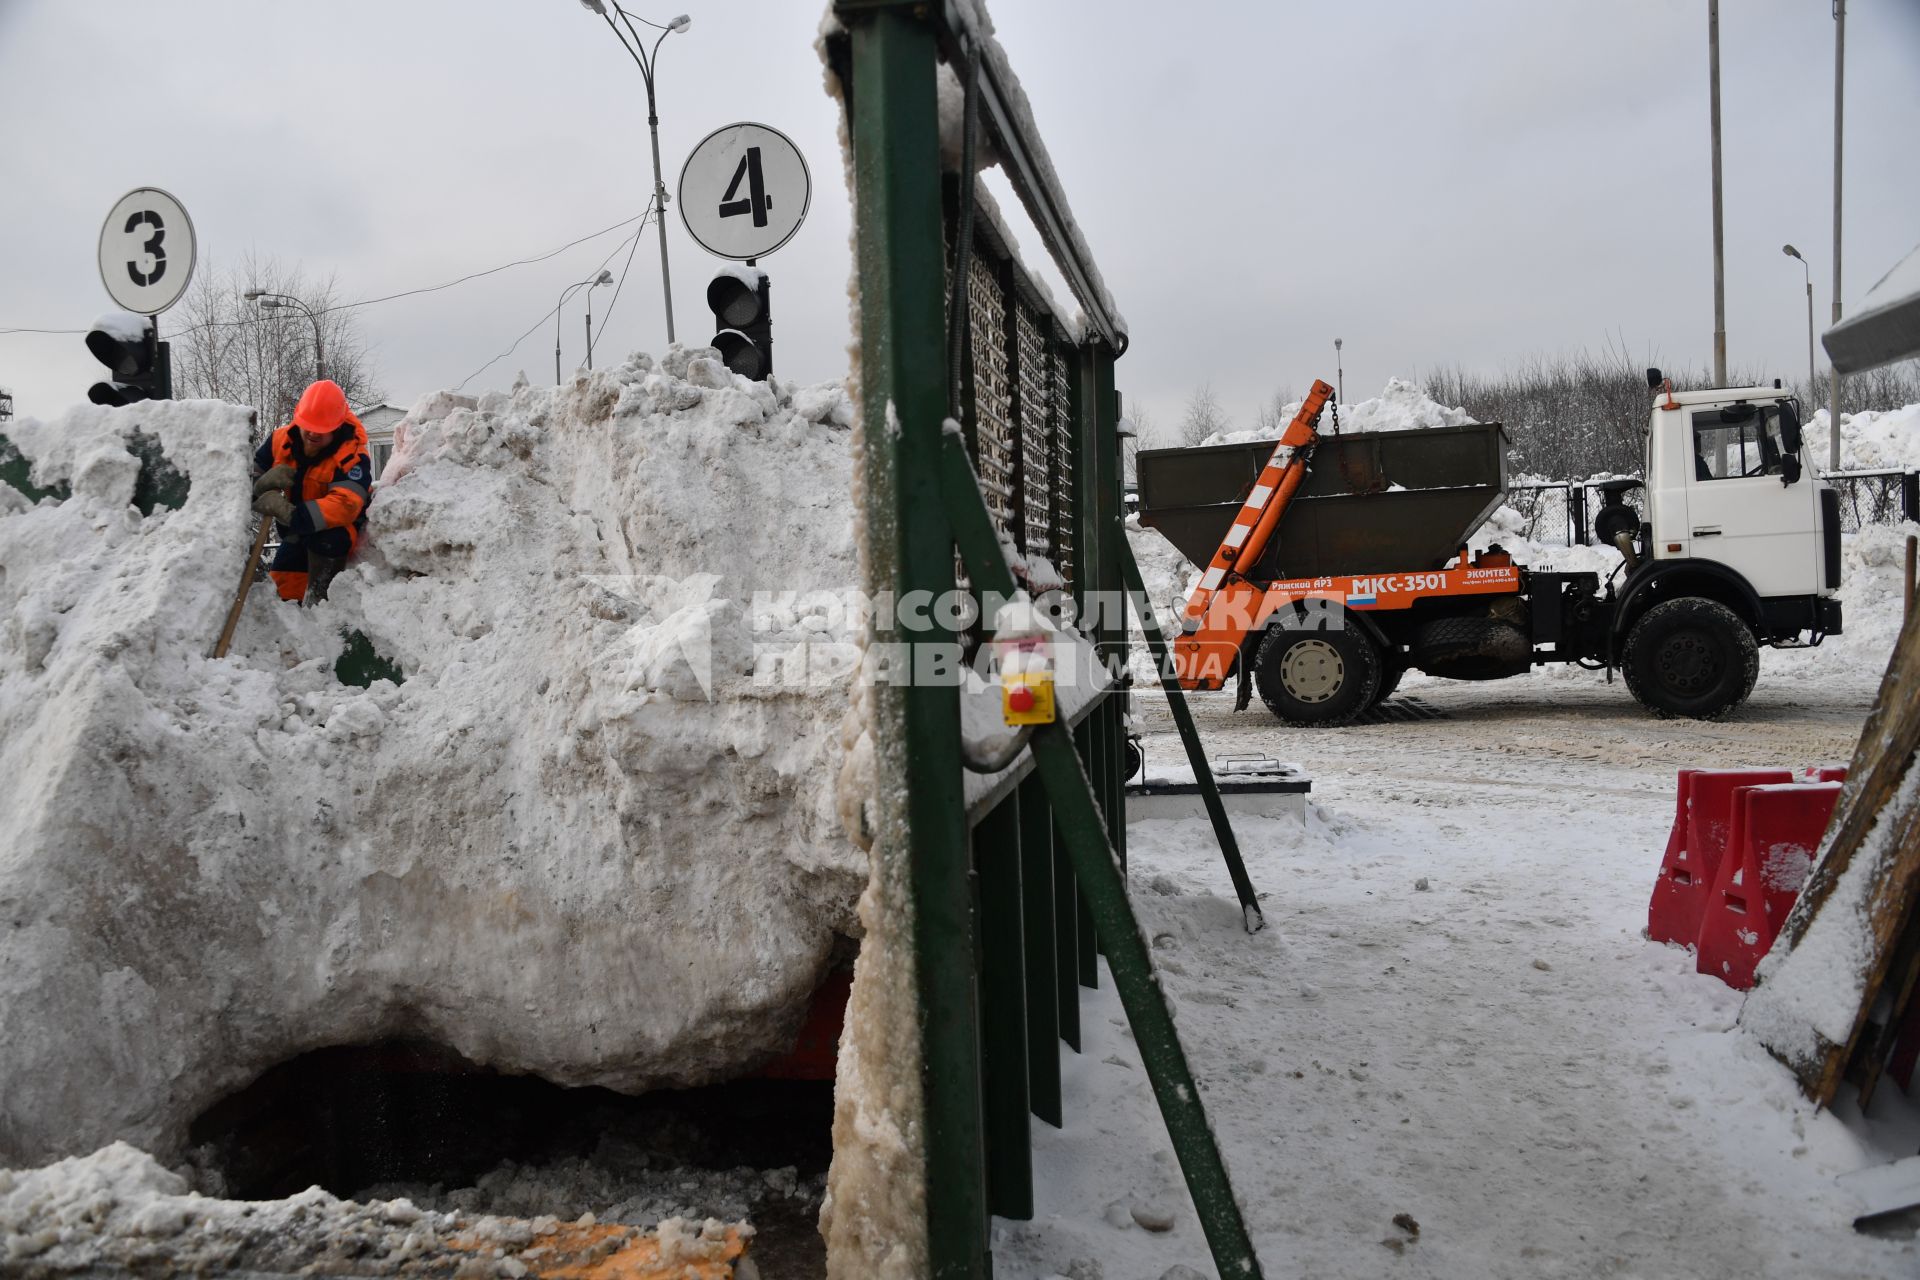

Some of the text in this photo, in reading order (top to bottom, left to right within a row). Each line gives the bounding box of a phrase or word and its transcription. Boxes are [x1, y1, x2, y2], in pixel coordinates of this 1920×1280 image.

[719, 147, 772, 227] 4
[125, 210, 166, 287] 3
[1313, 579, 1332, 588] АРЗ
[1352, 573, 1447, 595] МКС-3501
[1467, 569, 1510, 579] ЭКОМТЕХ
